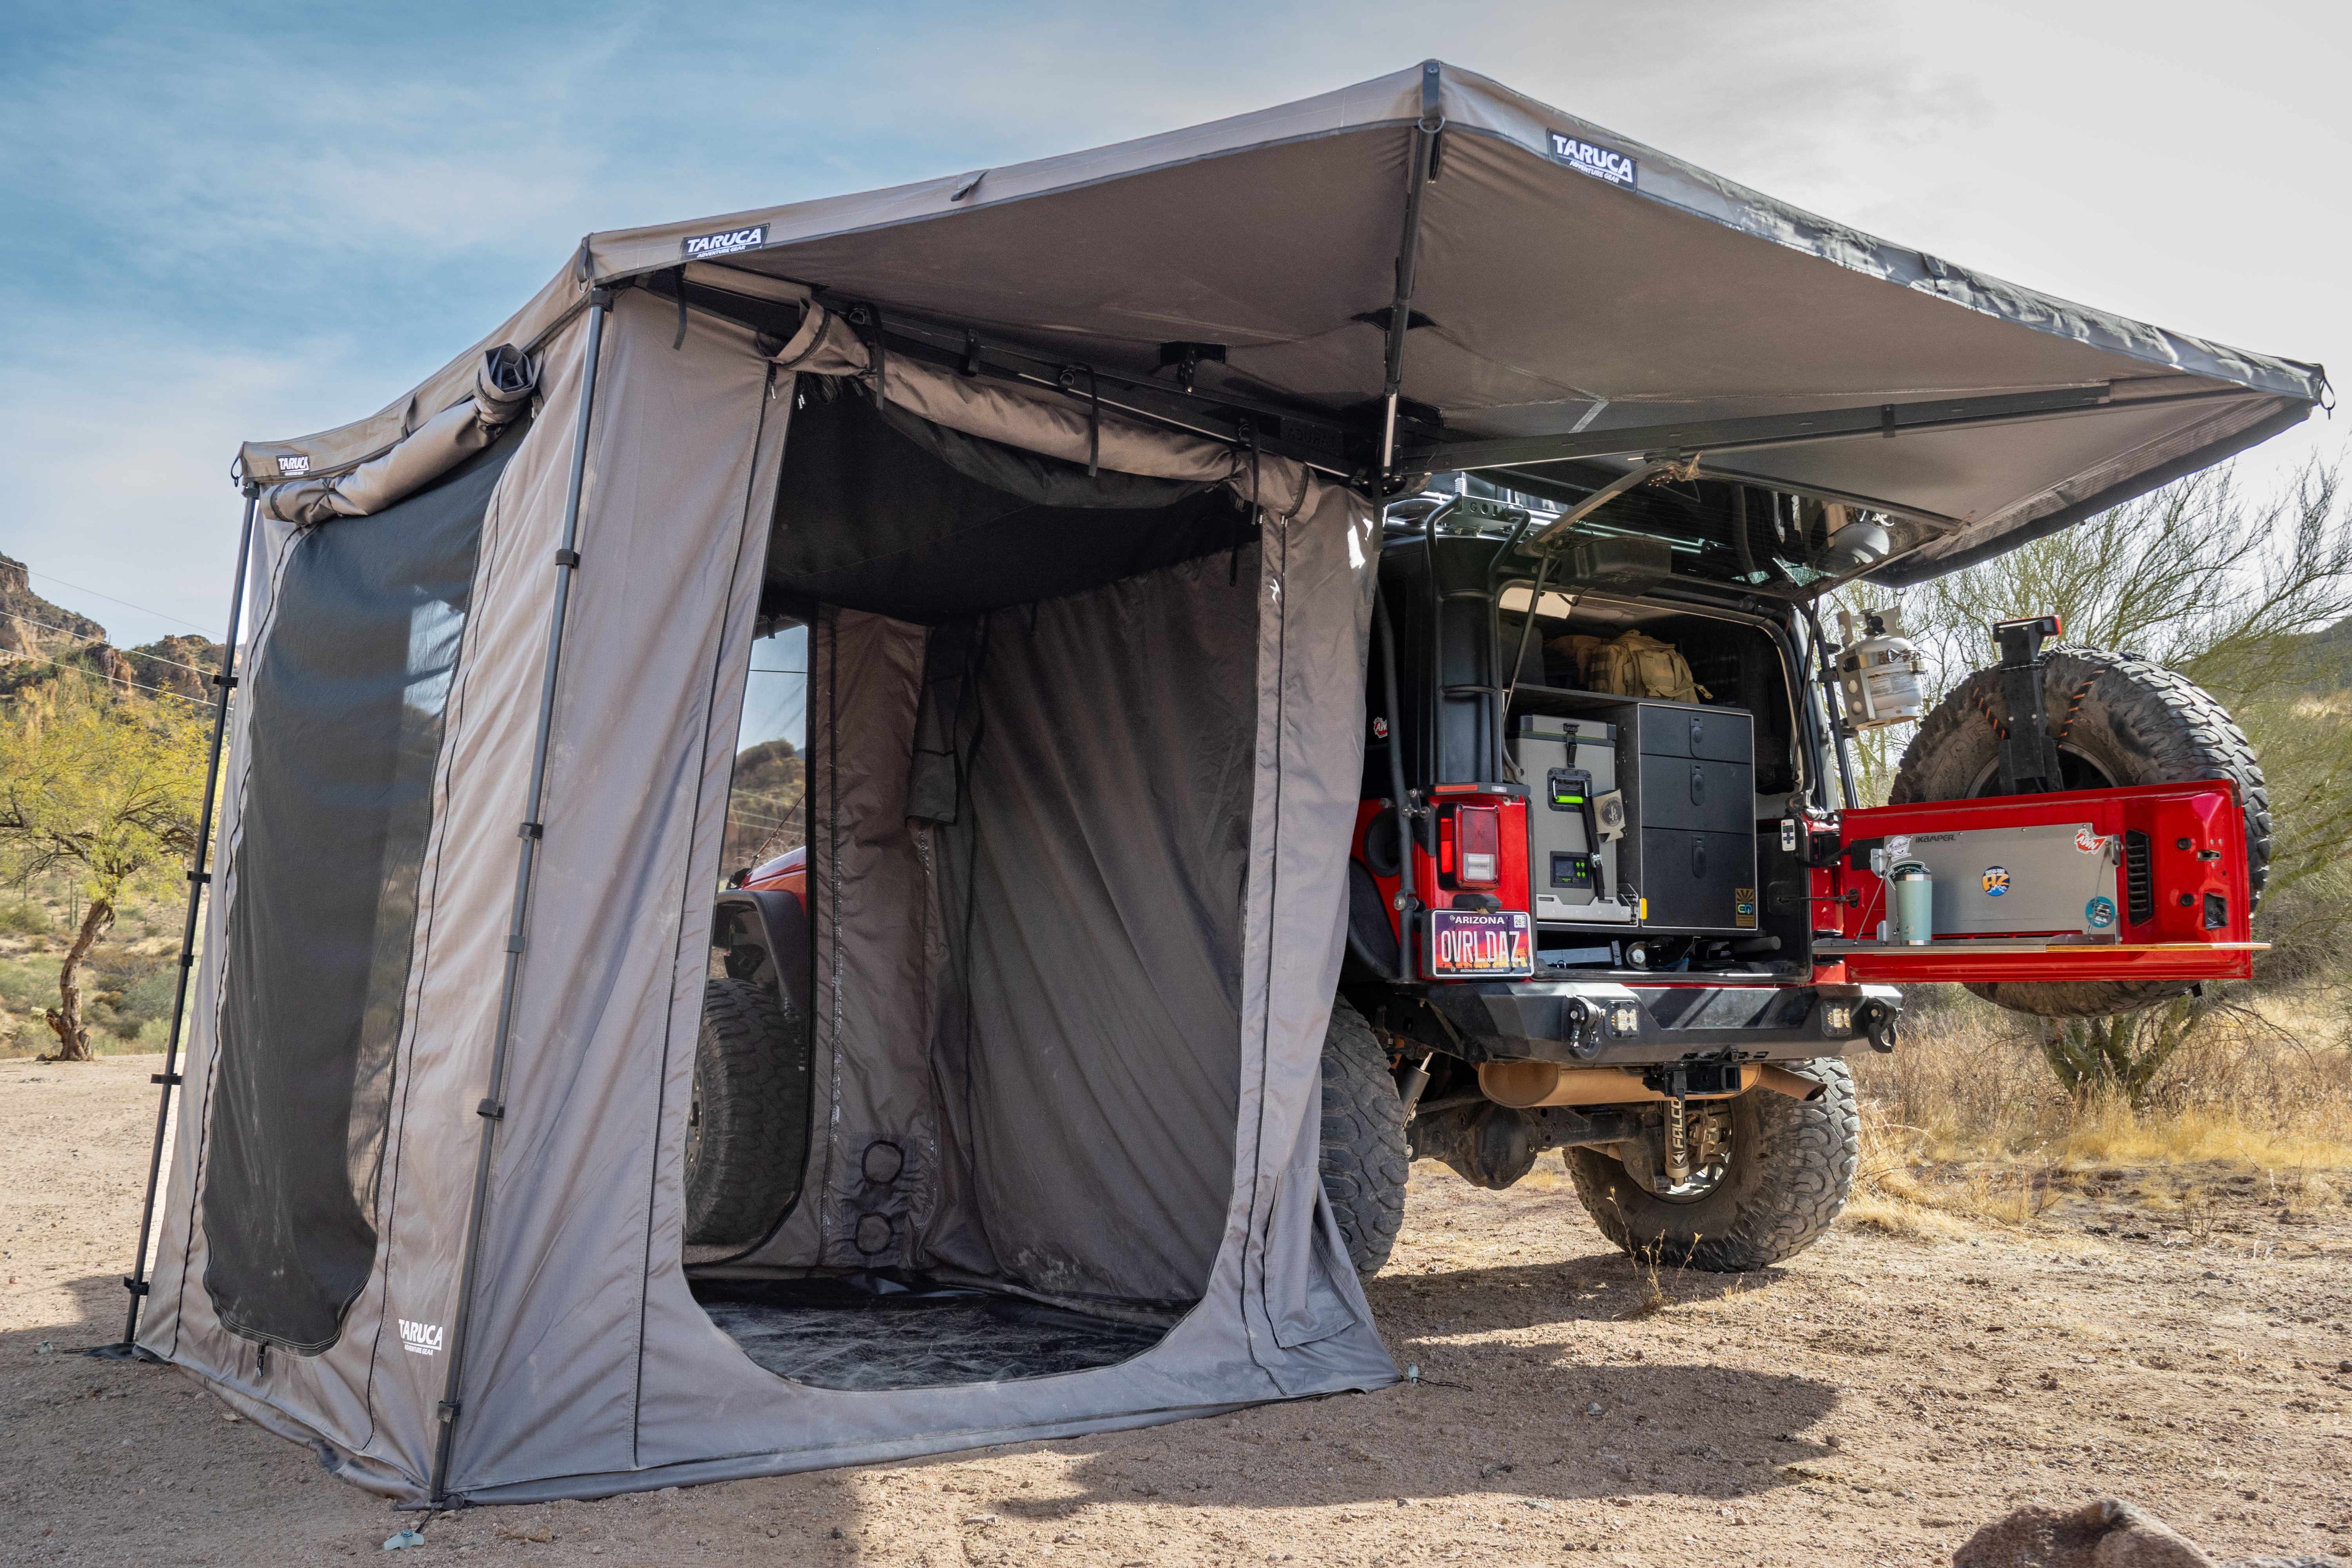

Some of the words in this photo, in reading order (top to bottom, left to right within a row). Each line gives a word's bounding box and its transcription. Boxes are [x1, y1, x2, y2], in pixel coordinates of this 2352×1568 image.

[1553, 134, 1633, 182] TARUCA
[1570, 160, 1604, 178] ADVENTURE
[1604, 172, 1620, 183] GEAR
[687, 228, 761, 253] TARUCA
[697, 248, 730, 258] ADVENTURE
[278, 457, 309, 470] TARUCA
[1470, 502, 1503, 516] GOB
[1982, 873, 2009, 891] AZ
[1455, 916, 1505, 924] ARIZONA
[1441, 931, 1521, 962] OVRLDAZ
[1671, 1100, 1684, 1148] FALCO
[399, 1319, 443, 1349] TARUCA
